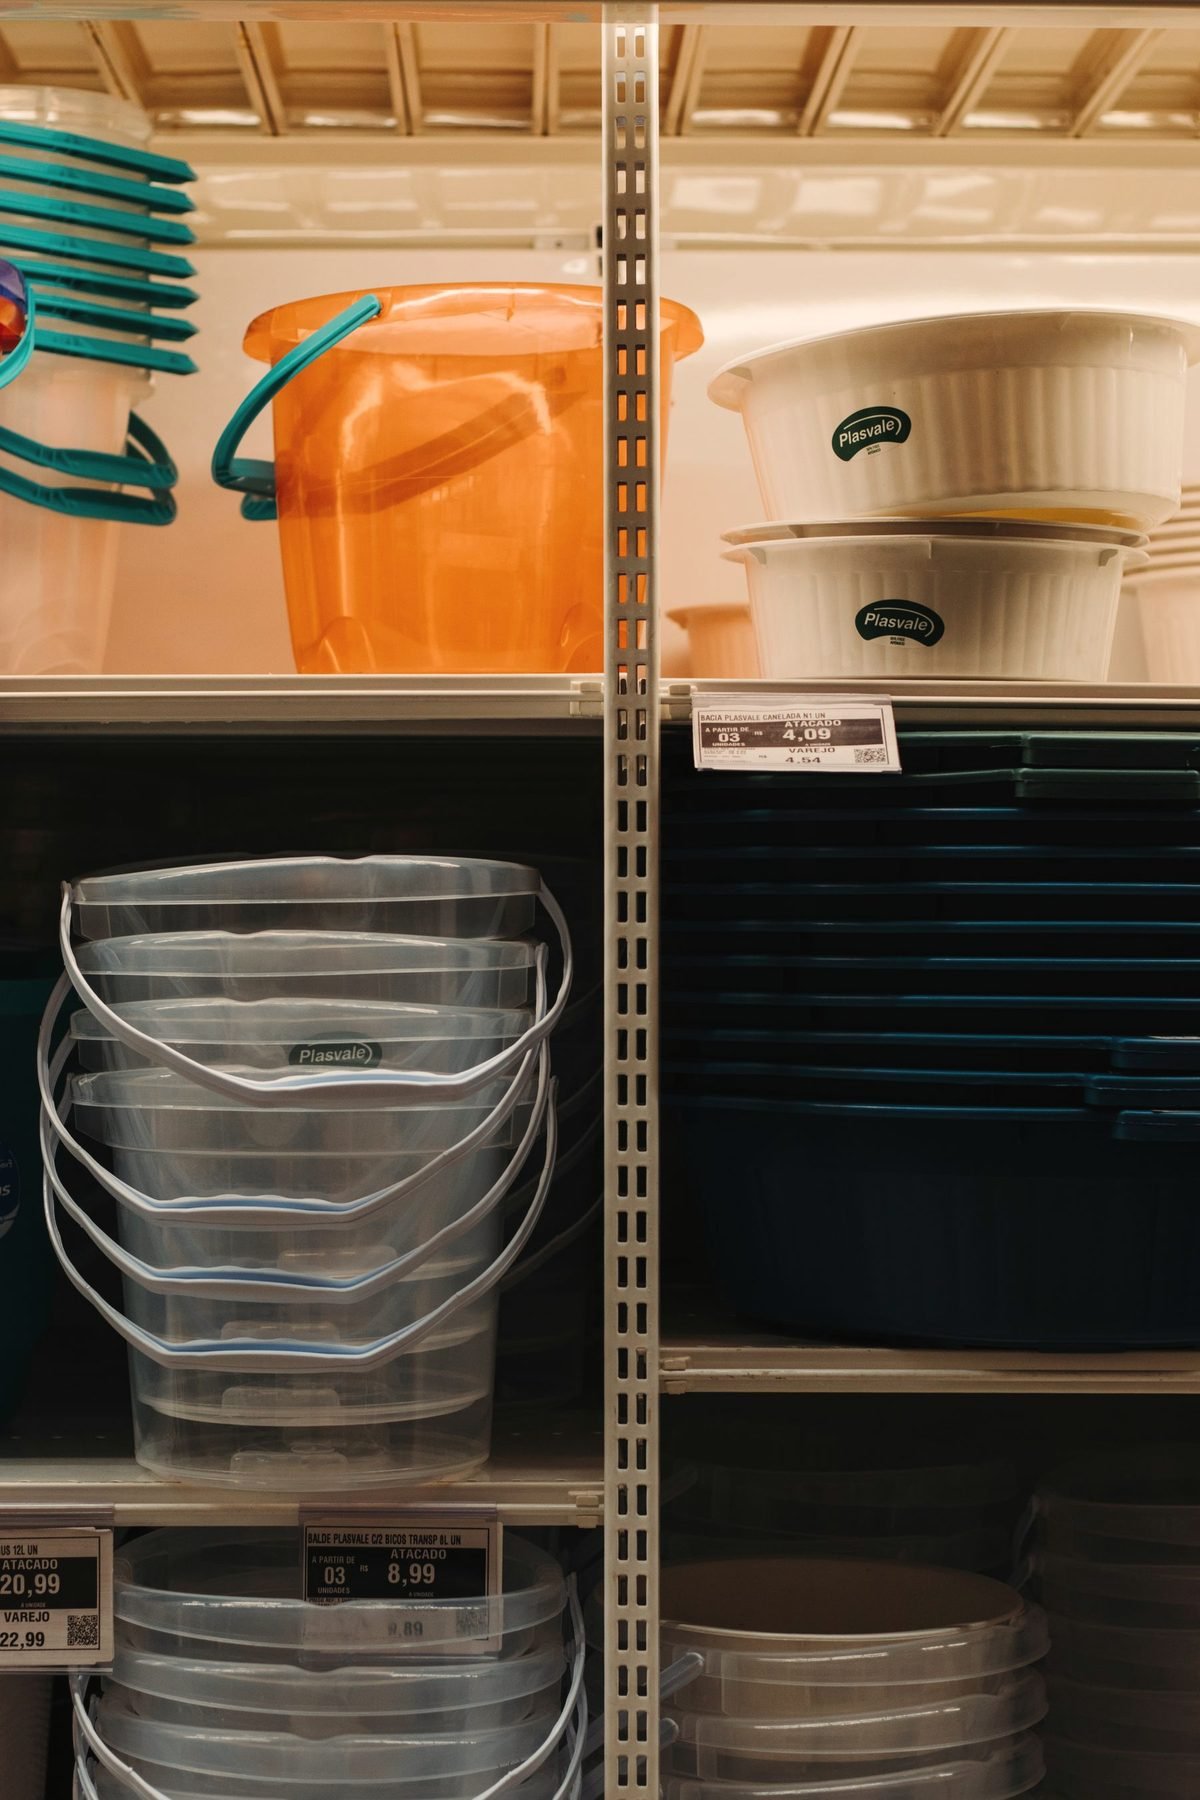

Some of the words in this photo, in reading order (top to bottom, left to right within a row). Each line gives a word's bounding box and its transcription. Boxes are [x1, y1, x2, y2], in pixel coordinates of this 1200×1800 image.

[839, 418, 895, 448] Plasvale
[864, 612, 928, 631] Plasvale
[701, 714, 723, 722] BACIA
[724, 714, 760, 722] PLASVALE
[763, 713, 802, 721] CANELADA
[784, 719, 842, 728] ATACADO
[718, 732, 741, 743] 03
[782, 727, 832, 743] 4,09
[299, 1045, 366, 1063] Plasvale
[308, 1533, 331, 1544] BALDE
[333, 1533, 369, 1545] PLASVALE
[371, 1534, 383, 1545] C/2
[385, 1534, 407, 1545] BICOS
[409, 1534, 438, 1545] TRANSP
[450, 1535, 461, 1546] UN
[13, 1545, 25, 1556] 12L
[27, 1544, 38, 1555] UN
[390, 1548, 447, 1560] ATACADO
[2, 1558, 58, 1570] ATACADO
[312, 1556, 317, 1564] A
[319, 1555, 345, 1564] PARTIR
[346, 1555, 356, 1564] DE
[359, 1564, 369, 1573] R$
[387, 1562, 436, 1587] 8,99
[324, 1566, 346, 1585] 03
[0, 1573, 61, 1599] 20,99
[317, 1586, 351, 1595] UNIDADES
[4, 1611, 50, 1622] VAREJO
[0, 1632, 45, 1649] 22,99
